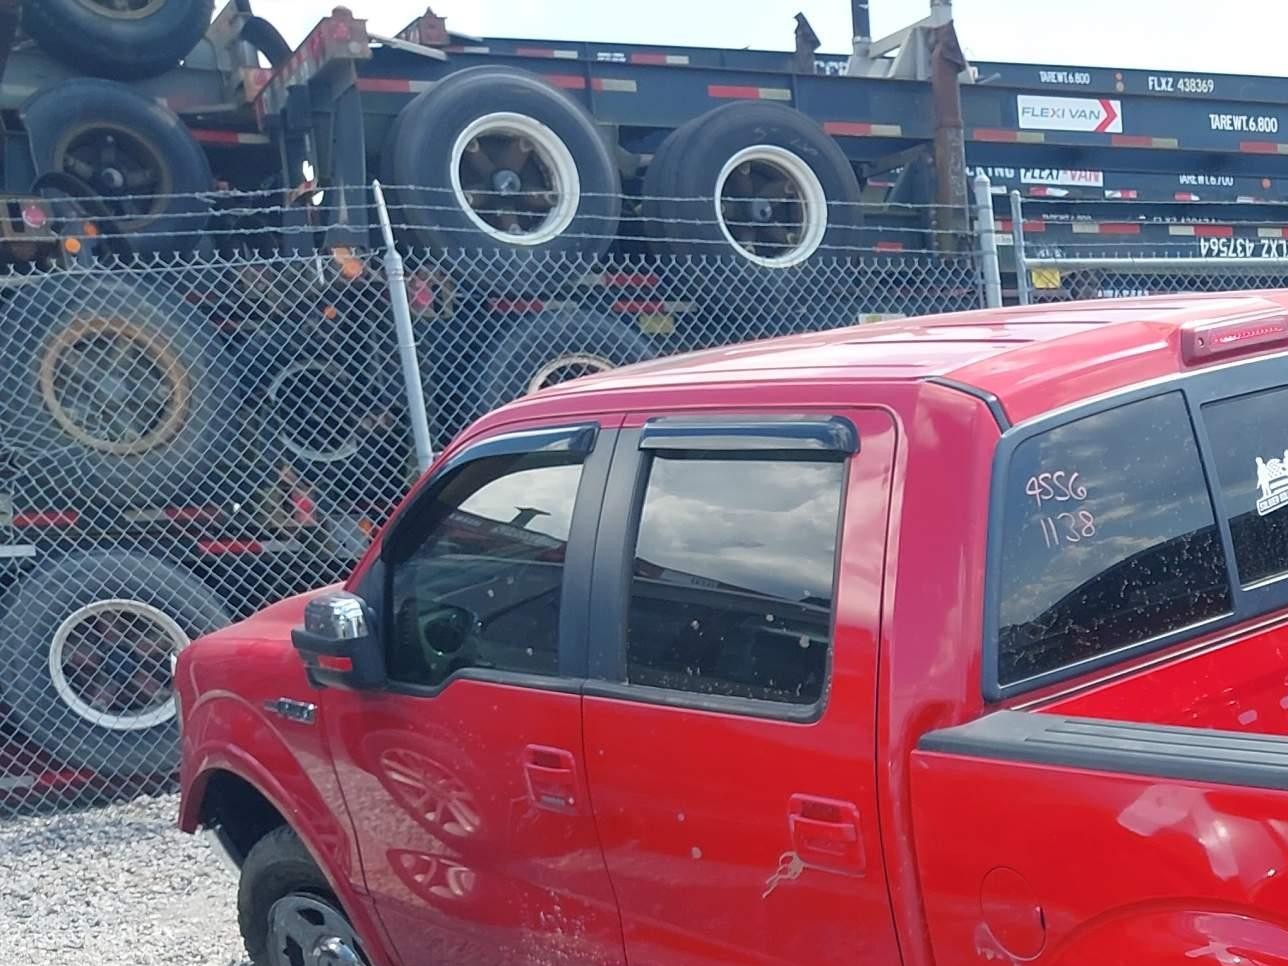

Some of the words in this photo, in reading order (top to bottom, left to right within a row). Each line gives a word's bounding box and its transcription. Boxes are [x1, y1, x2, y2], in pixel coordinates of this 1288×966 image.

[1148, 77, 1174, 92] FLXZ
[1177, 78, 1215, 93] 438369
[1021, 106, 1065, 119] FLEXI
[1069, 109, 1100, 120] VAN
[1200, 238, 1254, 258] 437564
[1040, 511, 1095, 549] 1138
